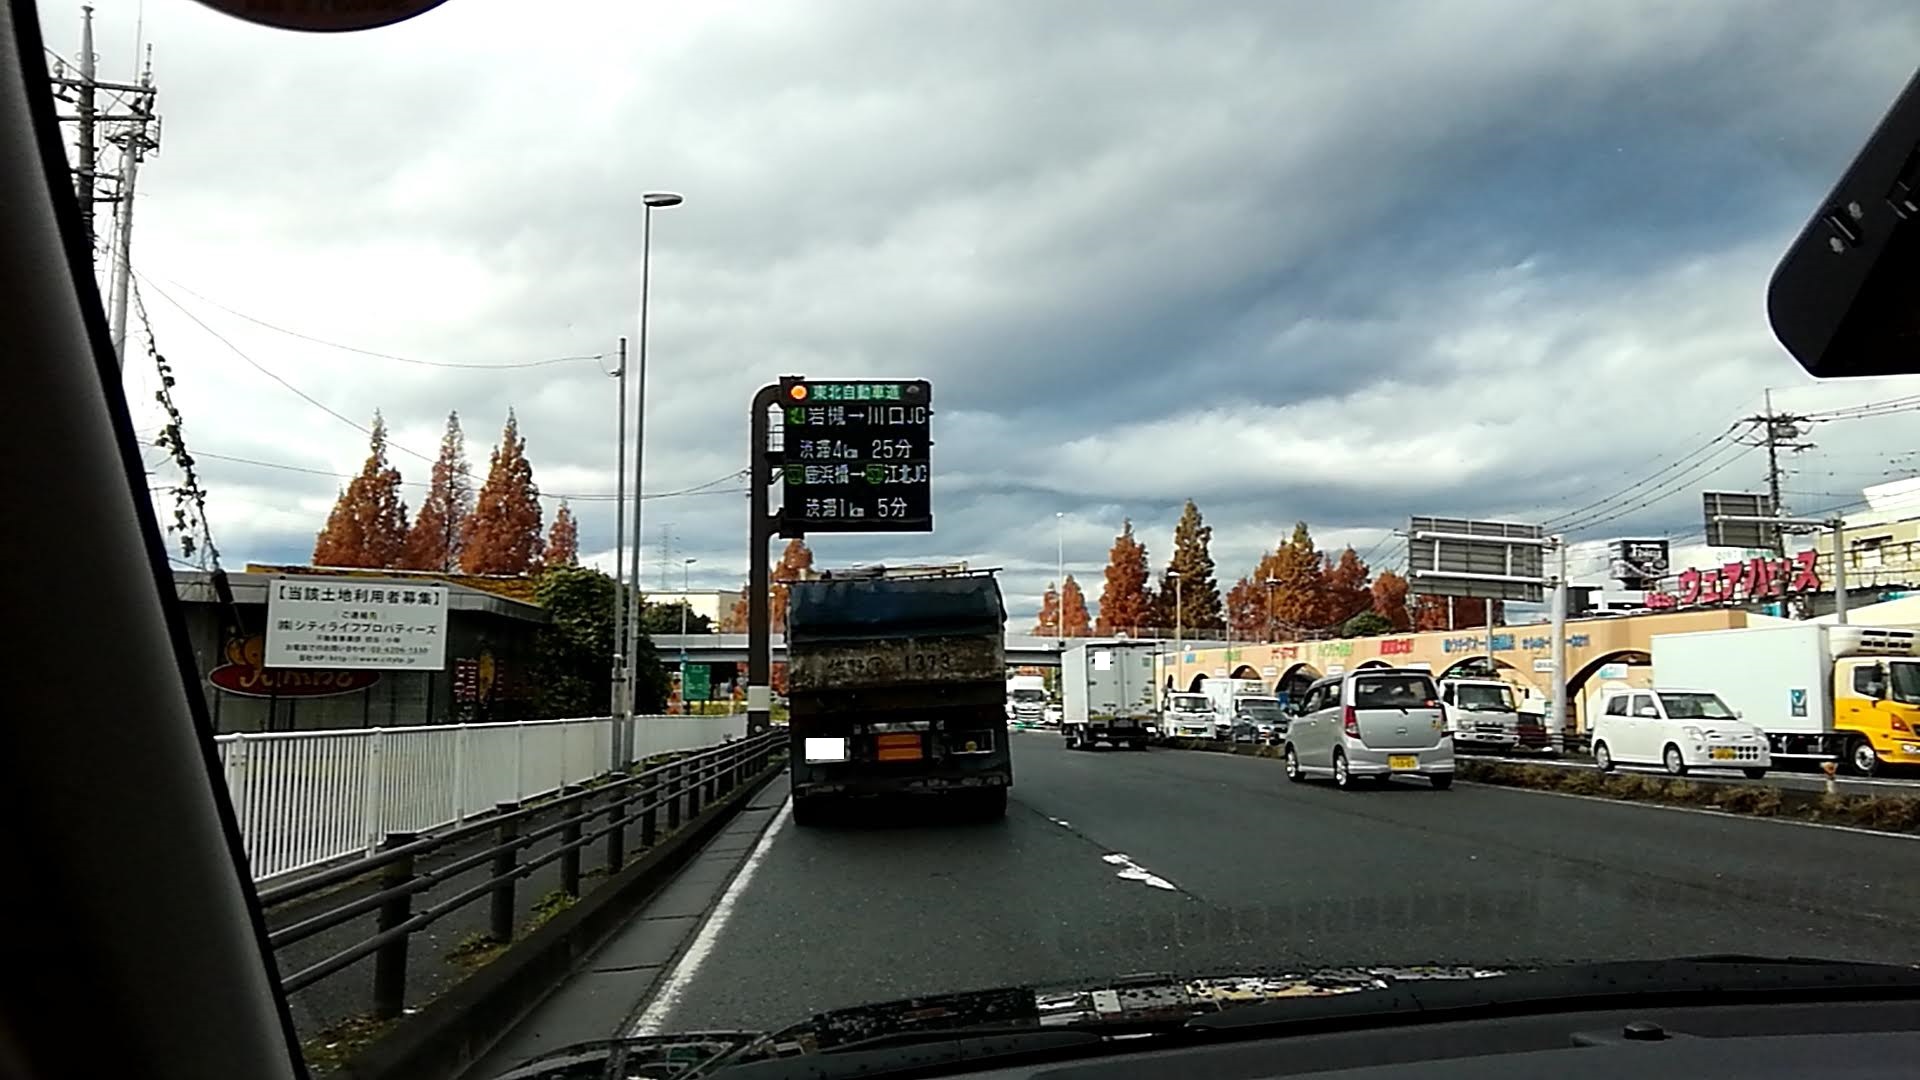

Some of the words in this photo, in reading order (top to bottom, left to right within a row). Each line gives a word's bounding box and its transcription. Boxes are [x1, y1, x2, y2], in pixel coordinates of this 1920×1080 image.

[813, 385, 900, 400] 東北自動車道
[867, 406, 926, 425] 川口JC
[872, 439, 912, 459] 25分
[878, 497, 907, 517] 5分
